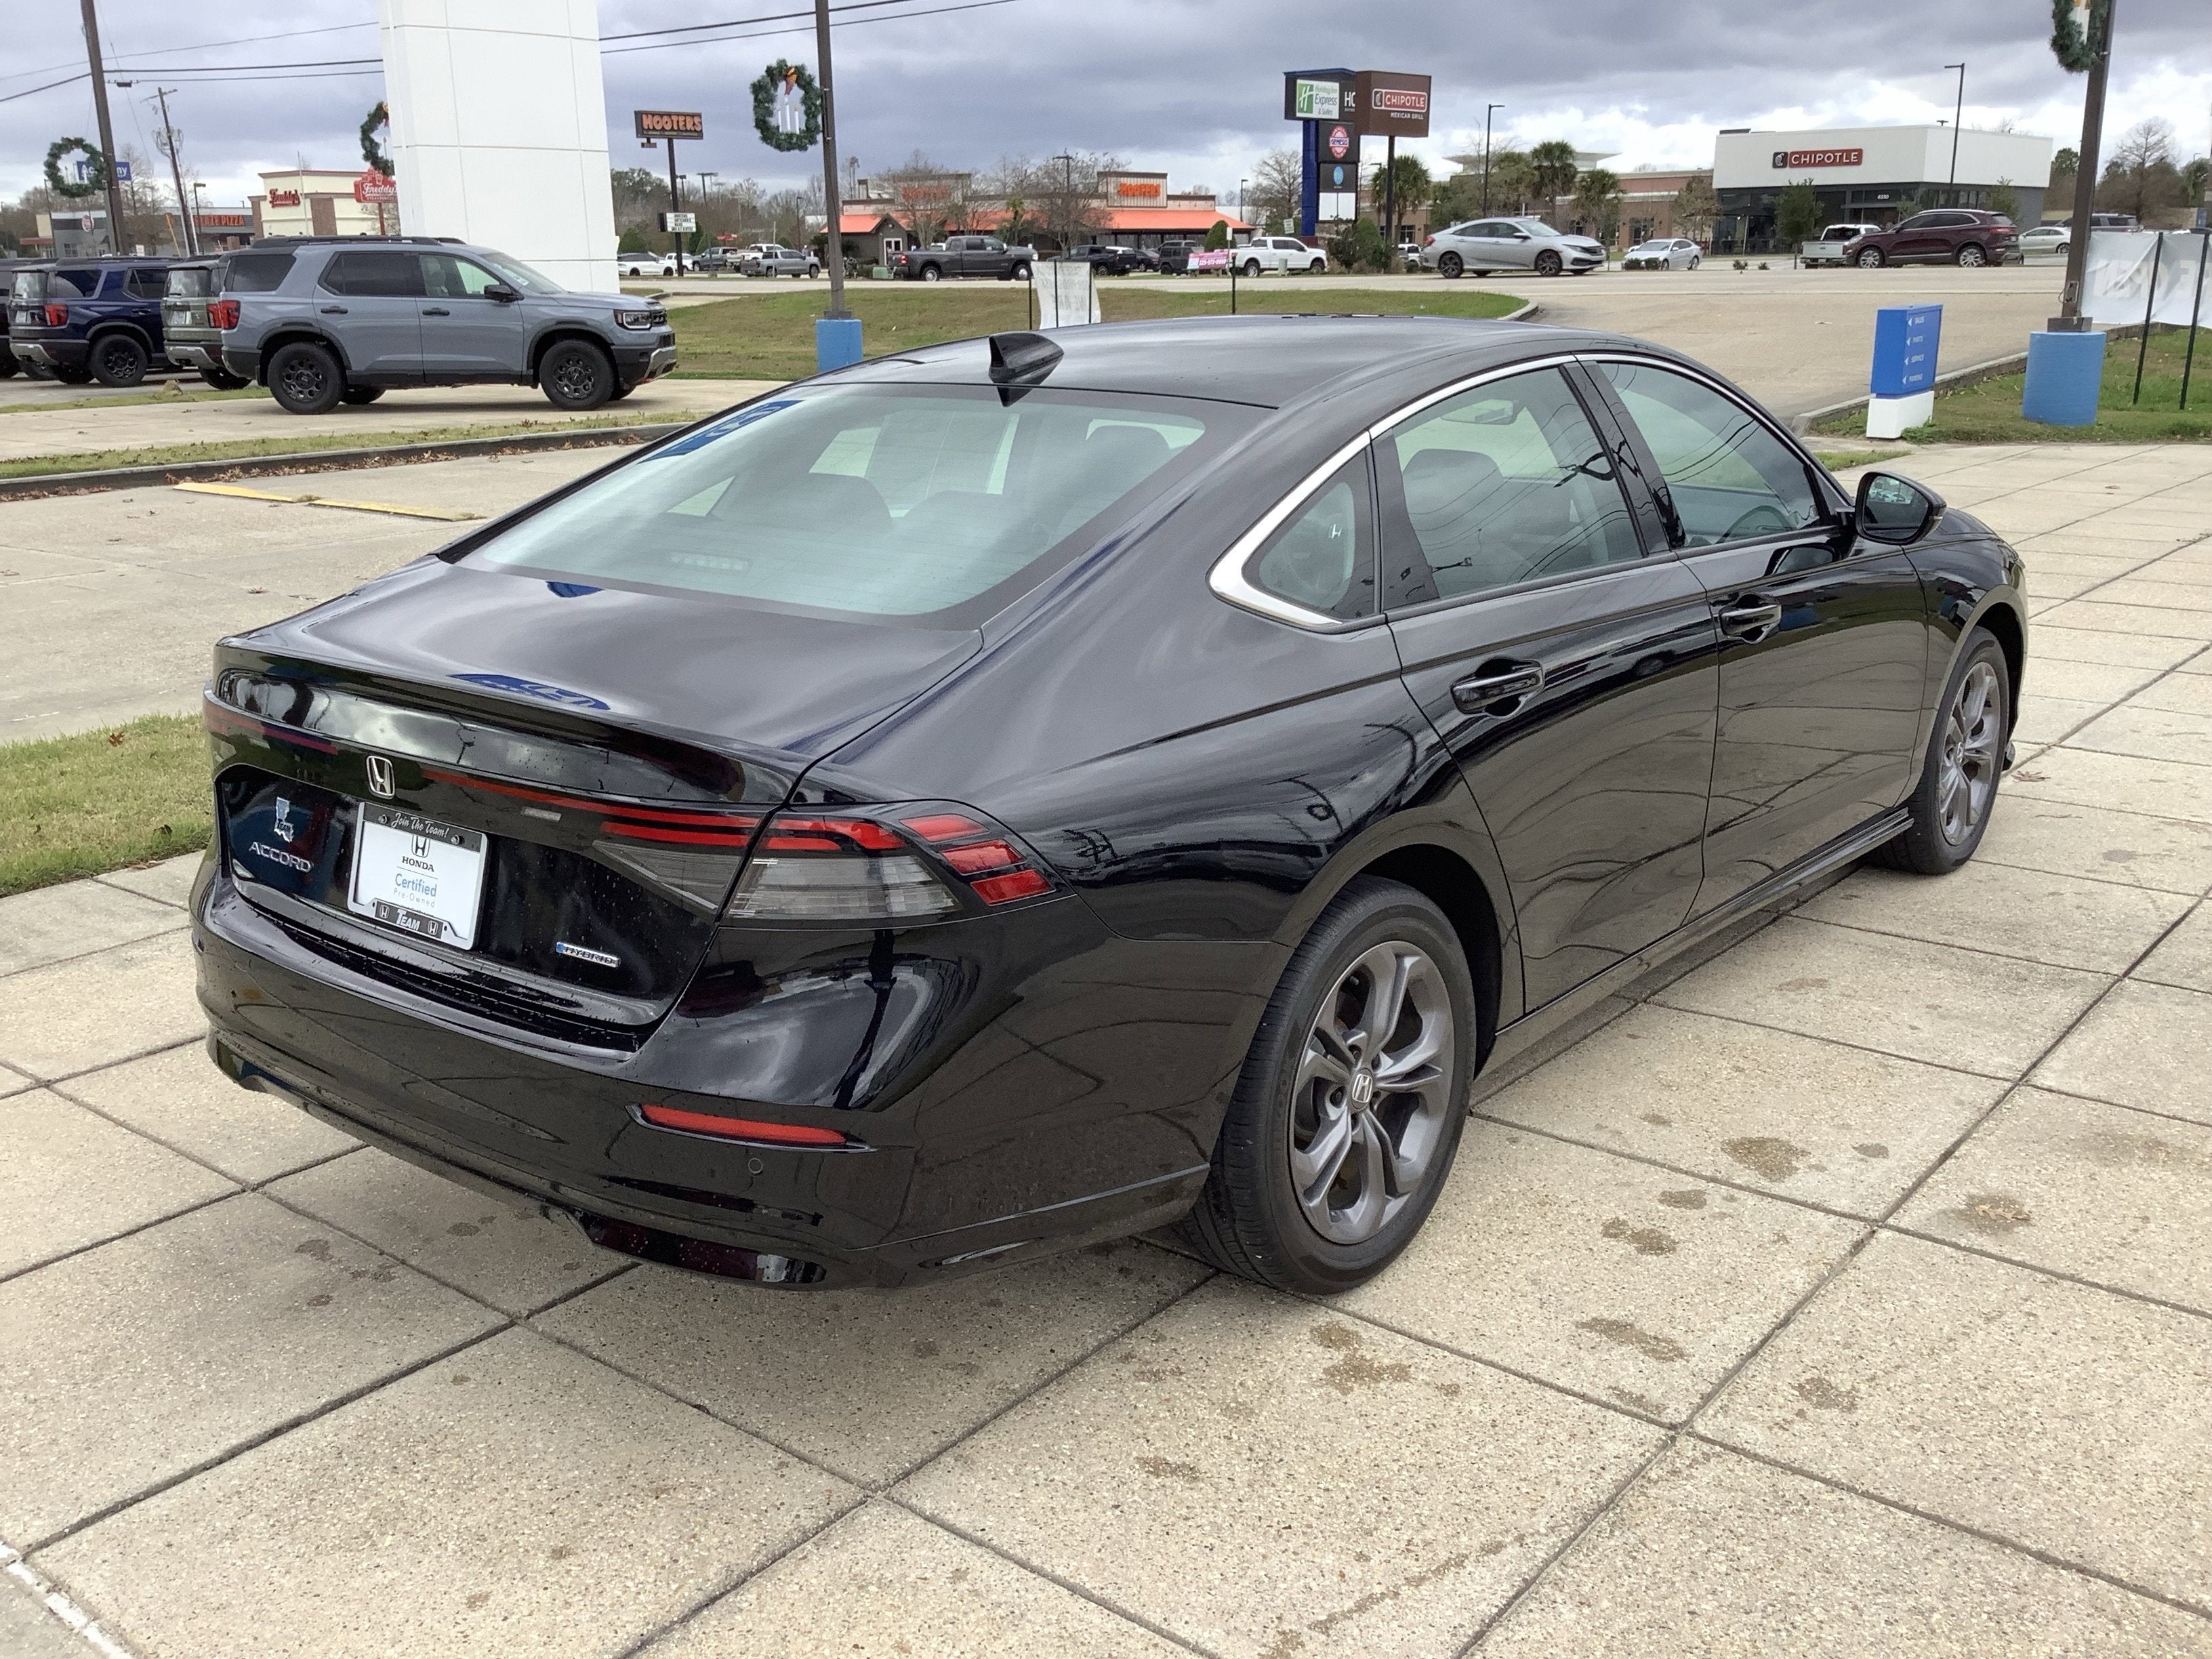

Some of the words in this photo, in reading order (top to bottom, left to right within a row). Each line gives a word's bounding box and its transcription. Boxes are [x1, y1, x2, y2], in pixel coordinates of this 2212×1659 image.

[1315, 94, 1338, 107] Express
[1385, 95, 1425, 107] CHIPOTLE
[642, 113, 701, 132] HOOTERS
[1791, 152, 1859, 165] CHIPOTLE
[391, 813, 409, 828] Join
[411, 817, 424, 832] The
[425, 821, 449, 838] Team!
[248, 841, 312, 873] ACCORD
[402, 855, 435, 873] HONDA
[395, 873, 438, 897] Certified
[394, 887, 436, 909] Pre-Owned
[565, 946, 613, 964] HYBRID
